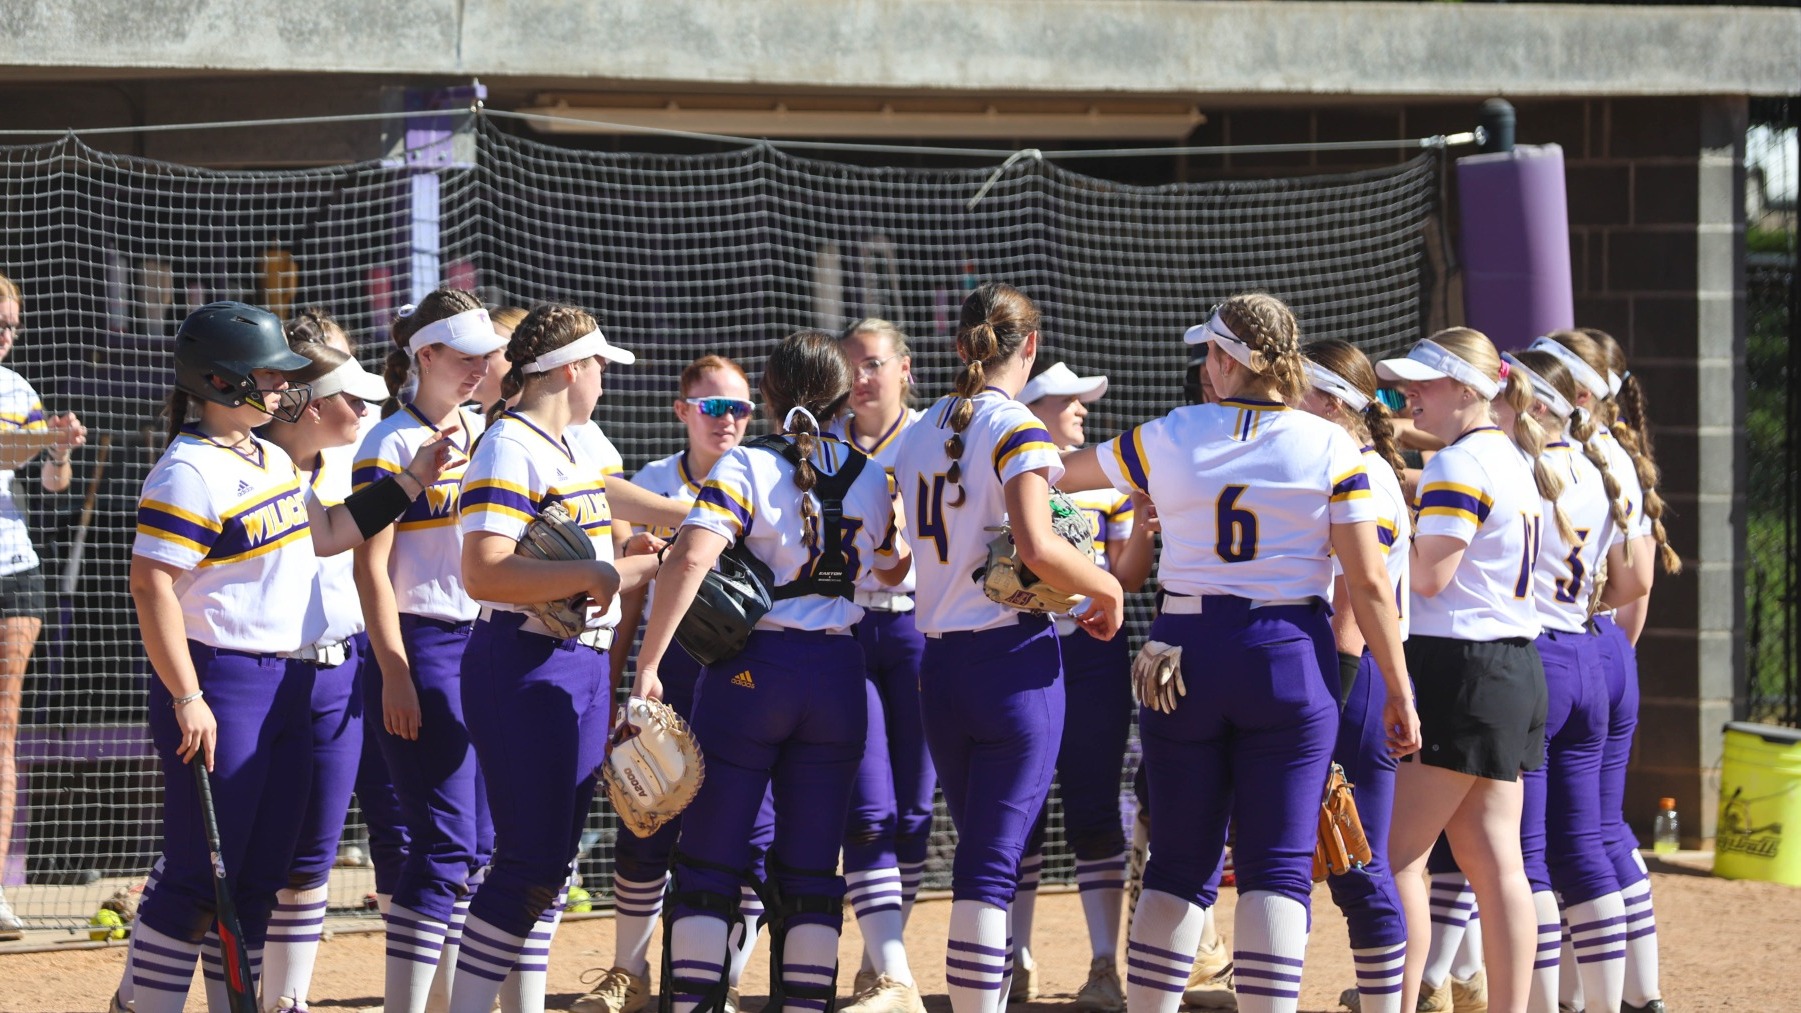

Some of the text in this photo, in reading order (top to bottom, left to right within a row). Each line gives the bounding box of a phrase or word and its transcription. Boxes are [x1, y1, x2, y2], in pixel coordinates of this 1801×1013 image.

[916, 471, 949, 565] 4
[1213, 483, 1260, 563] 6
[1552, 527, 1592, 604] 3
[623, 767, 648, 797] A2000
